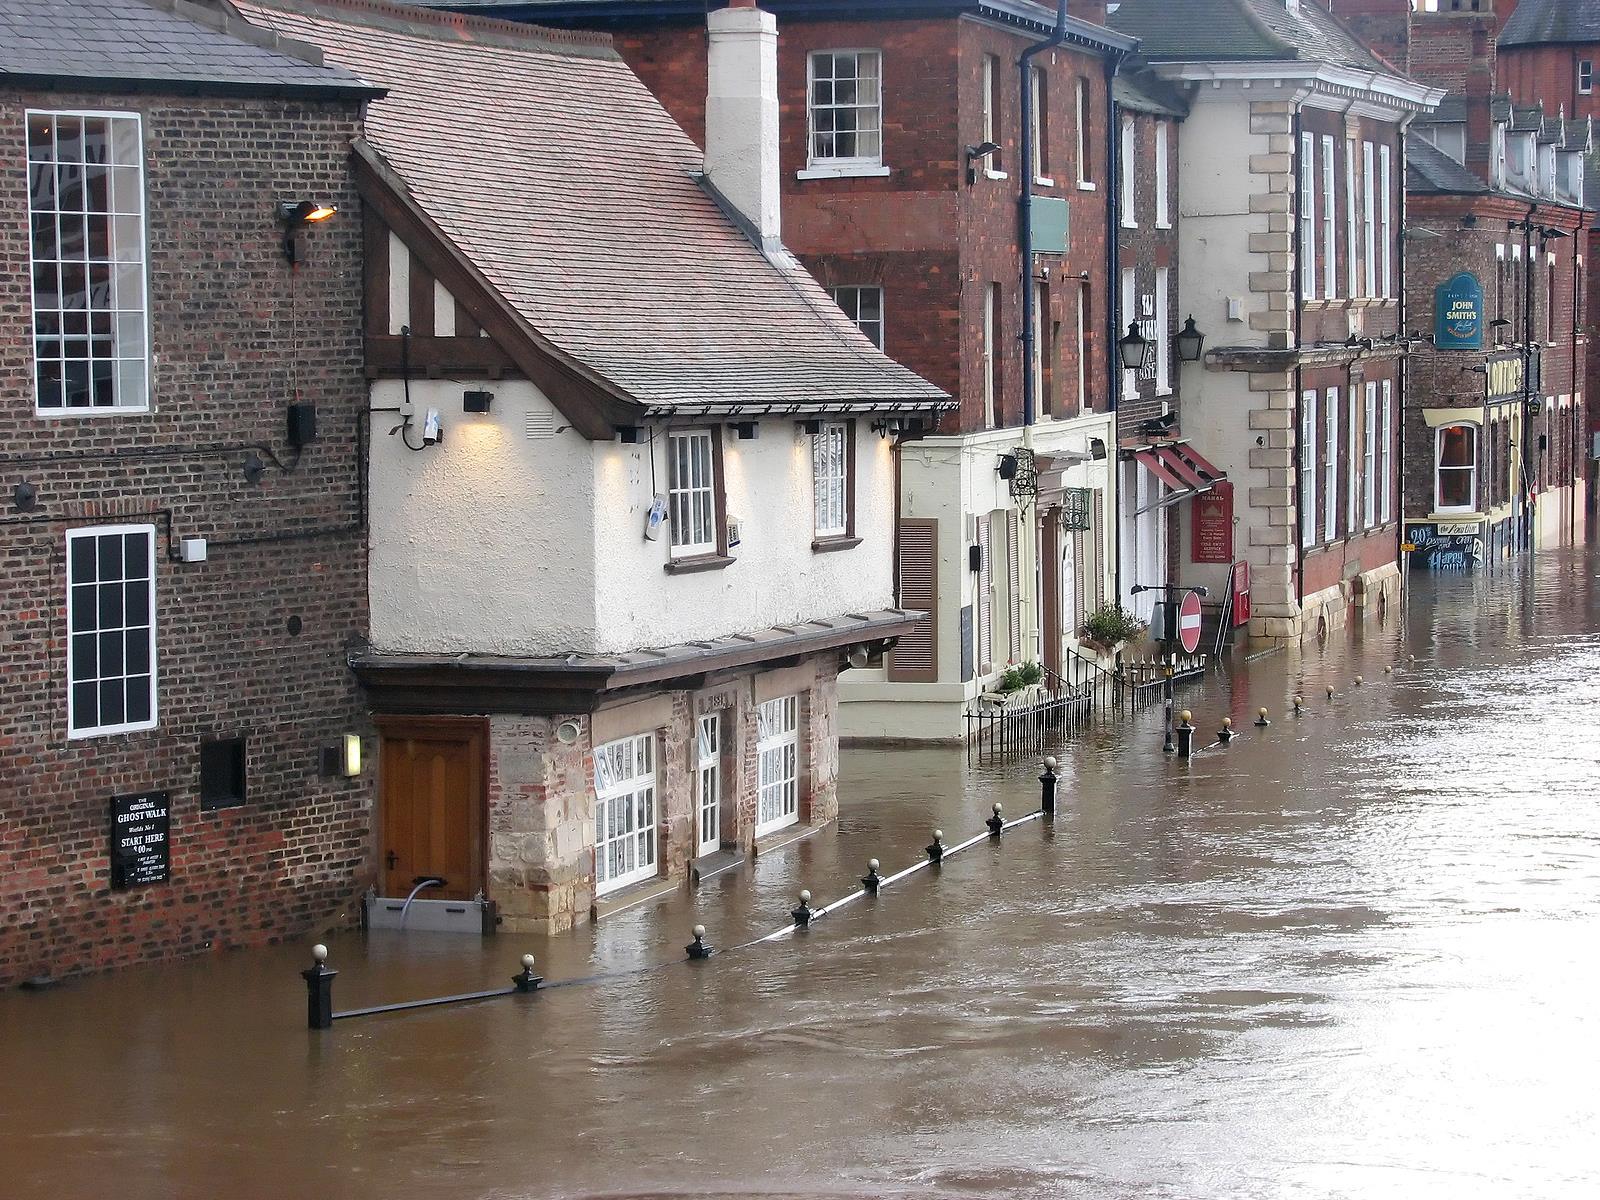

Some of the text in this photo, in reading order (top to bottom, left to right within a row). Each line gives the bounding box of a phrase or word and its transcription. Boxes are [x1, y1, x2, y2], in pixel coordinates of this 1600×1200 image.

[1452, 301, 1473, 311] JOHN
[1446, 311, 1477, 320] SMITH'S
[130, 802, 155, 810] ORIGINAL
[118, 809, 166, 823] GHOST WALK
[121, 834, 164, 847] START HERE
